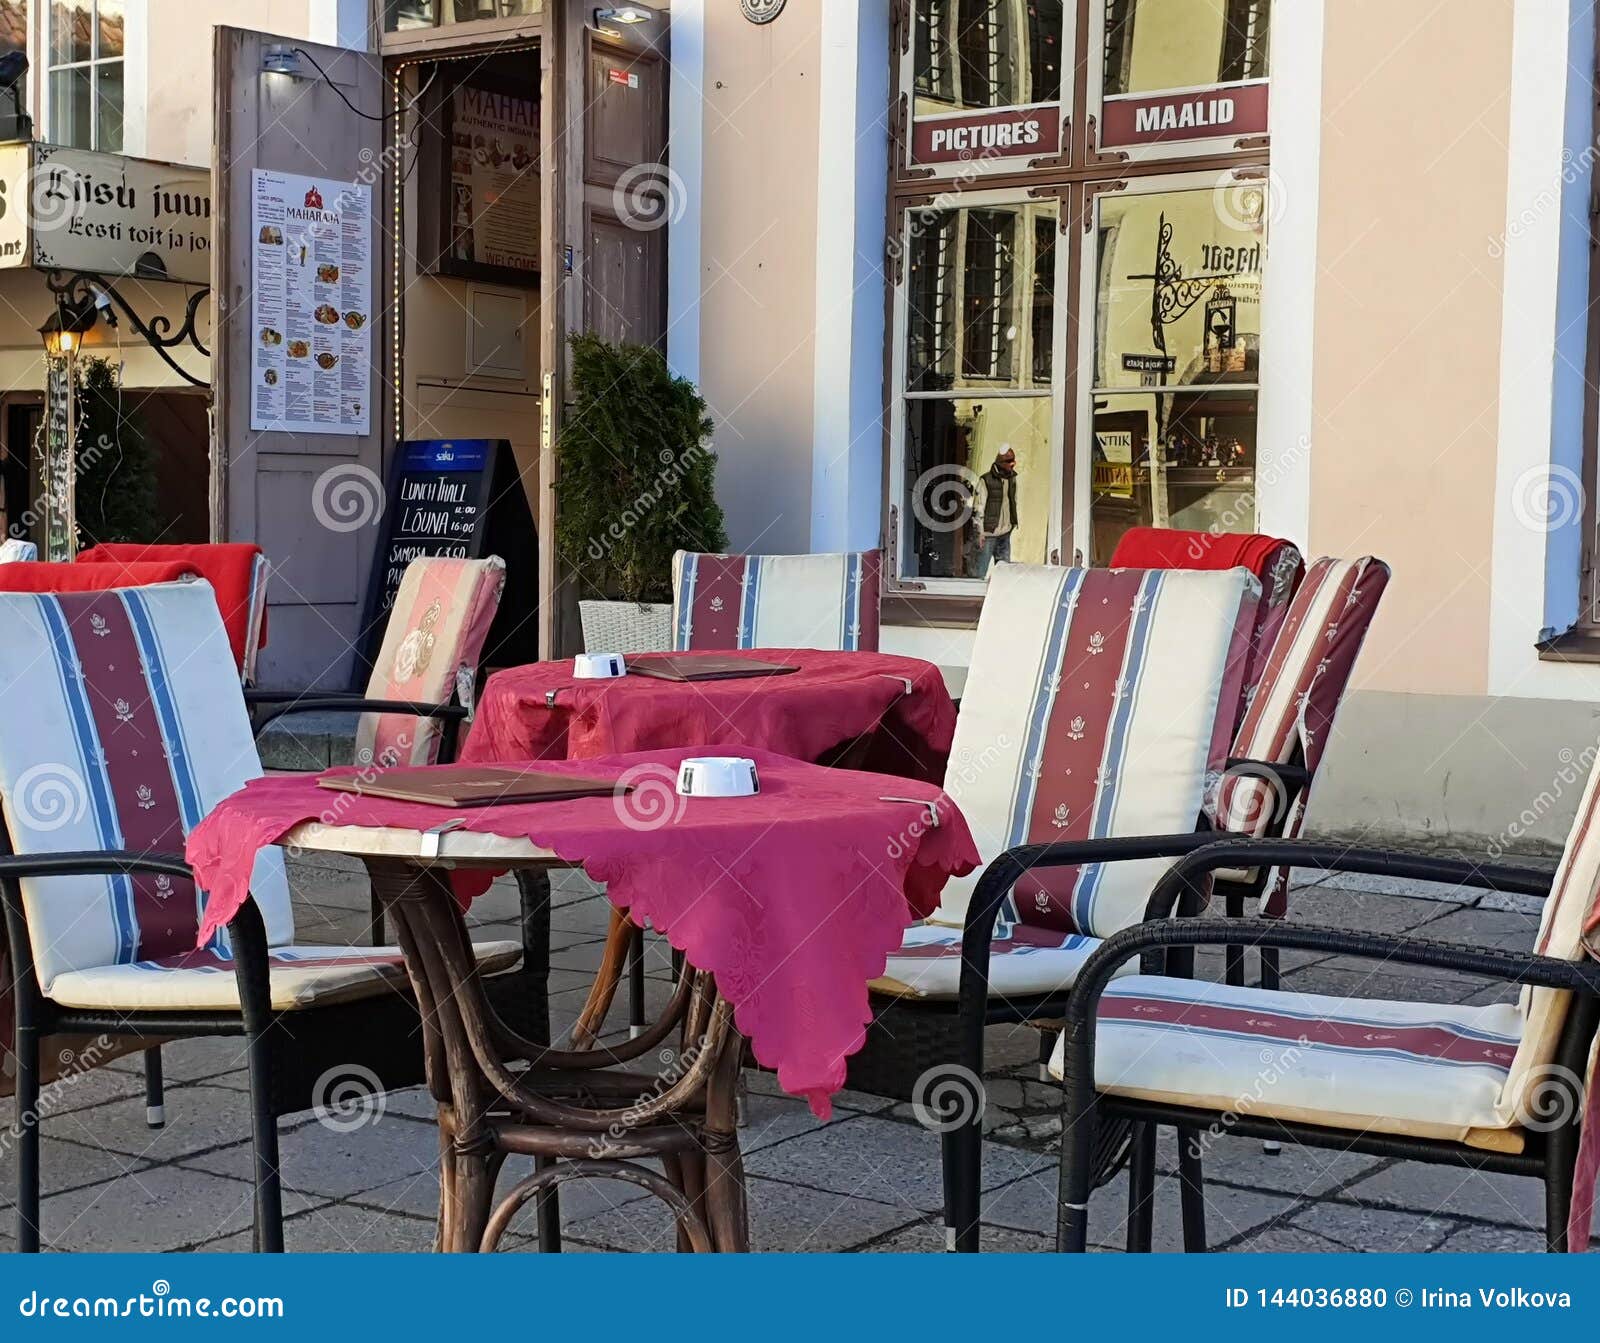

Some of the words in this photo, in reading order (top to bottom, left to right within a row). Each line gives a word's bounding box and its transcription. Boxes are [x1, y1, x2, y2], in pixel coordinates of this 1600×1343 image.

[1135, 98, 1235, 133] MAALID
[931, 120, 1039, 152] PICTURES
[286, 206, 340, 225] MAHARAJA
[129, 226, 163, 245] toit
[169, 229, 183, 250] ja
[486, 251, 538, 269] WELCOME
[435, 450, 455, 462] saku
[401, 478, 436, 502] LUNCH
[401, 507, 450, 535] LÕUNA
[450, 520, 475, 533] 16:00
